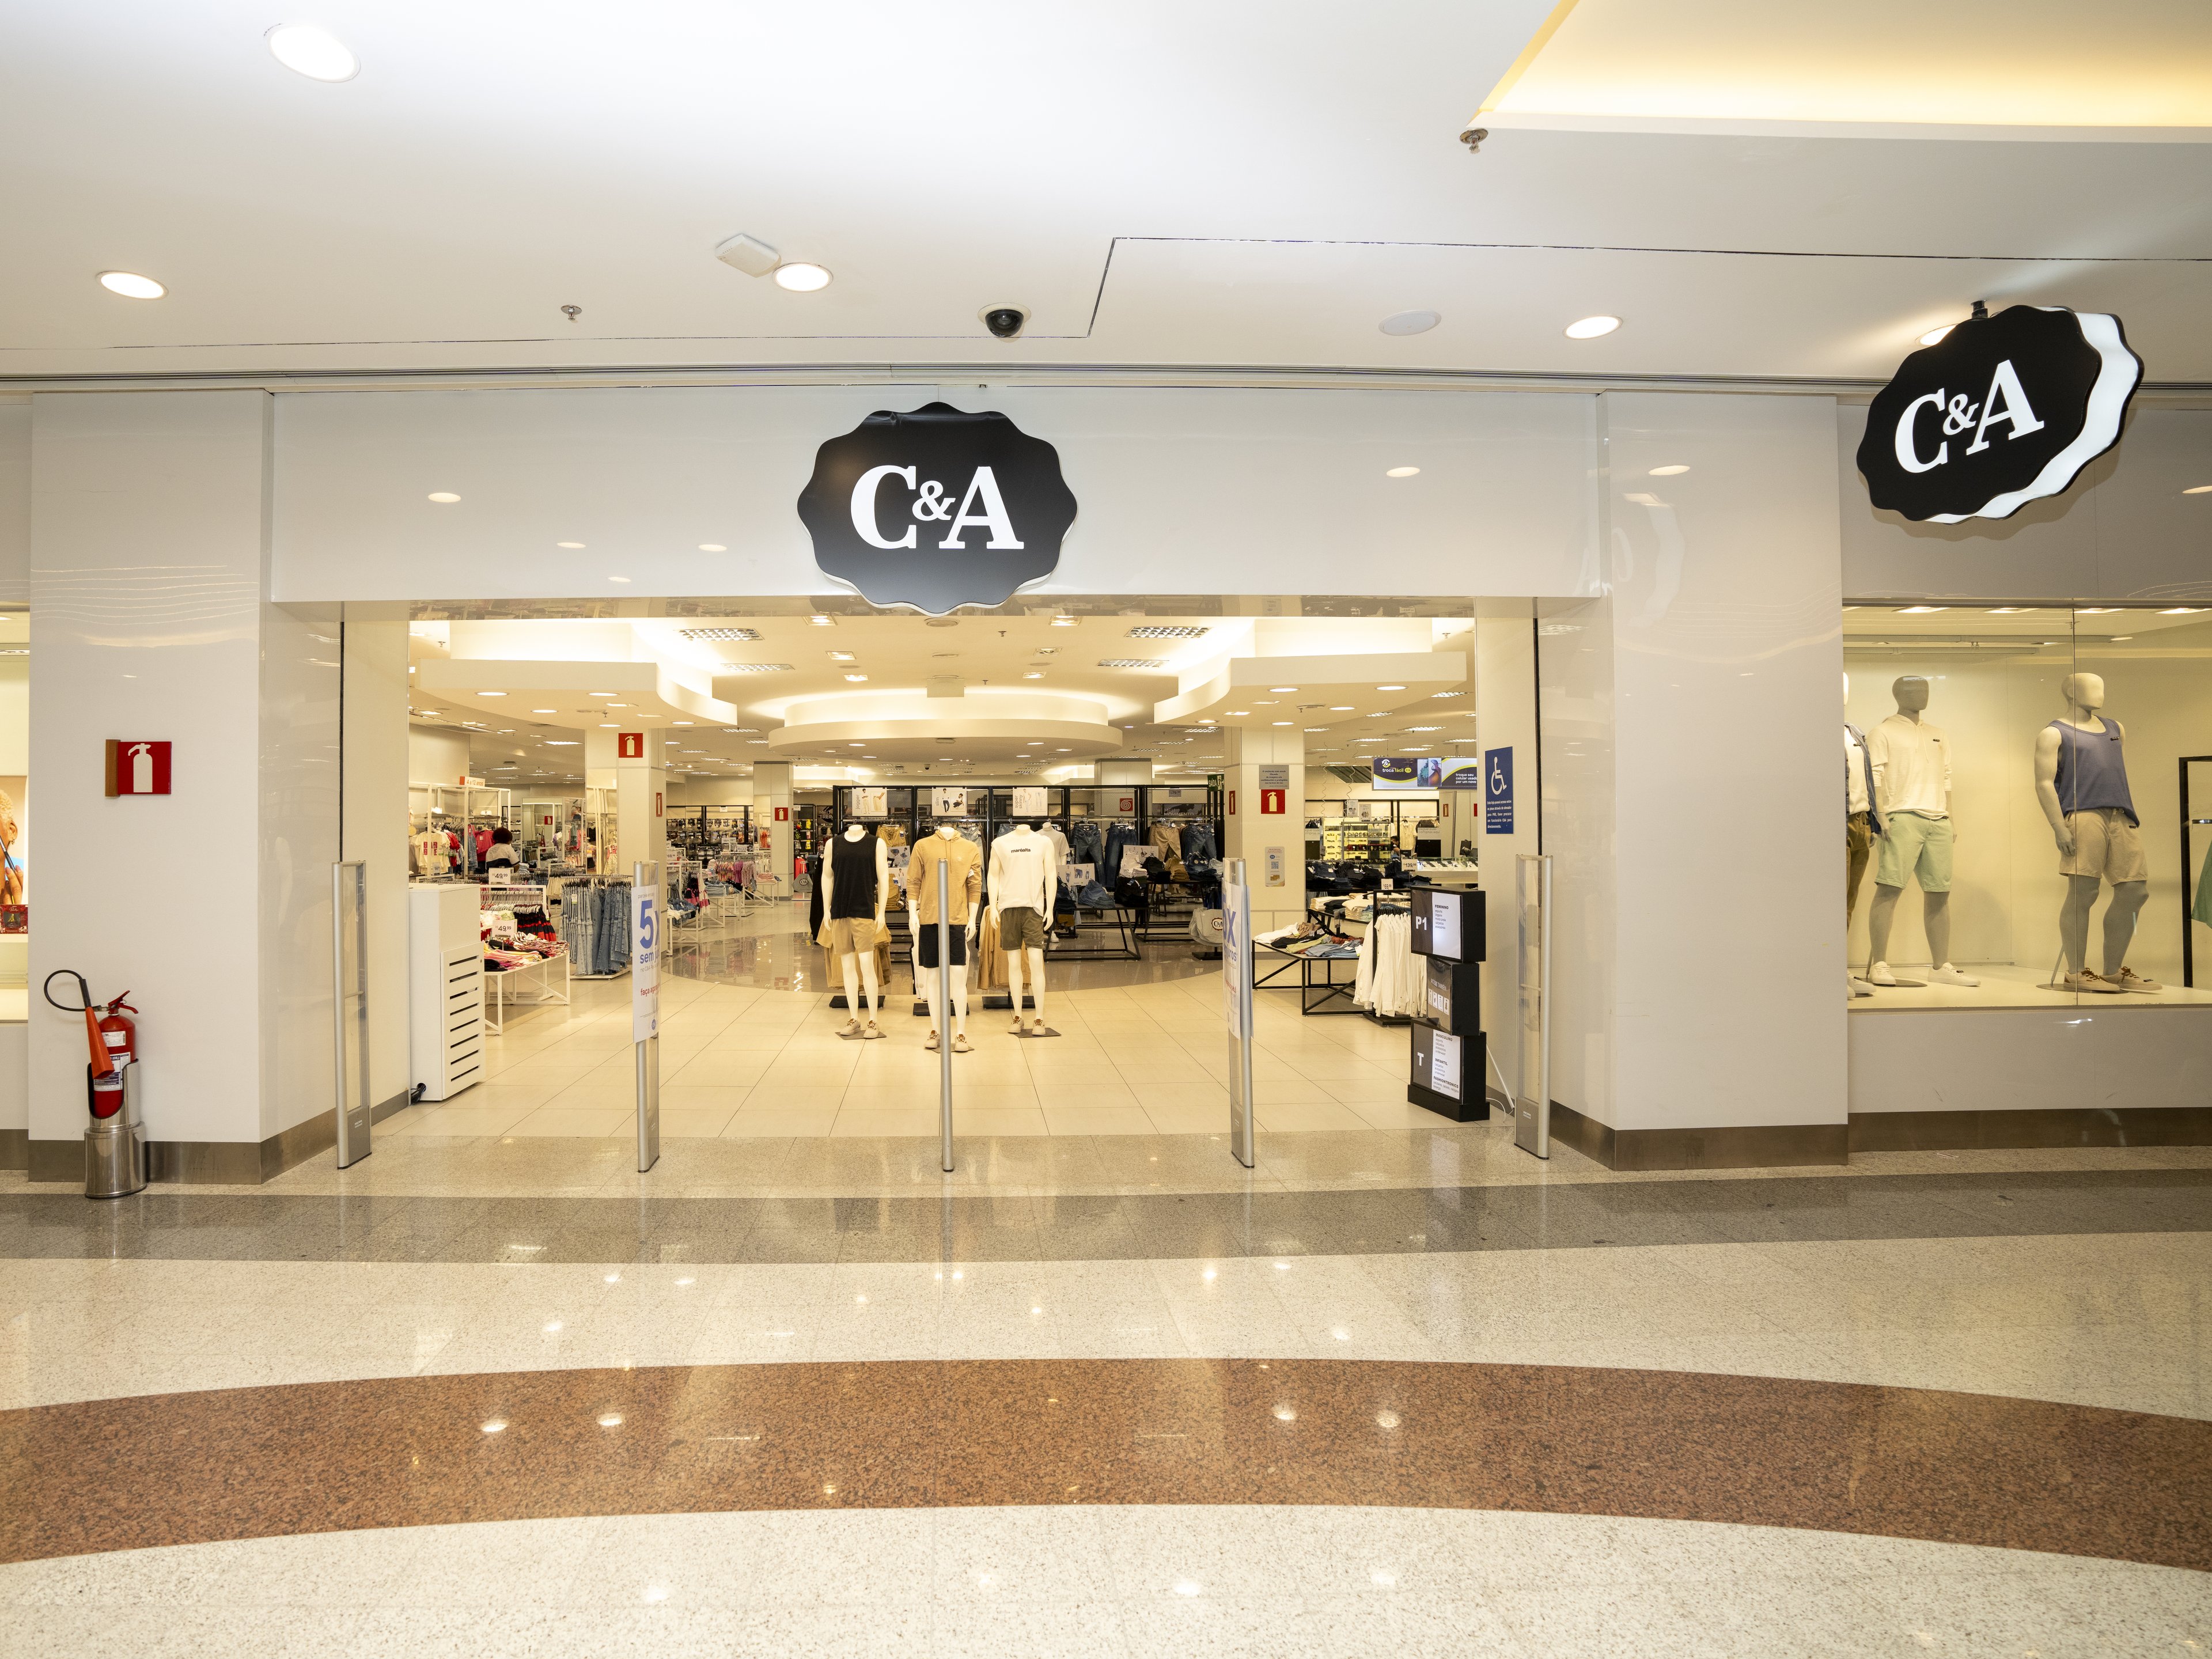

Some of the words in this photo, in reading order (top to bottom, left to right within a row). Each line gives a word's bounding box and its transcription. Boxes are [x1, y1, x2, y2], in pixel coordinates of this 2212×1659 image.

[1895, 359, 2044, 473] C&A
[850, 465, 1024, 549] C&A
[1209, 778, 1217, 787] SAÍDA
[1416, 916, 1427, 930] P1
[640, 952, 654, 964] sem
[641, 988, 650, 997] faça
[1435, 1033, 1453, 1041] MASCULINO
[1418, 1052, 1424, 1066] T
[1433, 1076, 1459, 1088] FASHIONTRONICS
